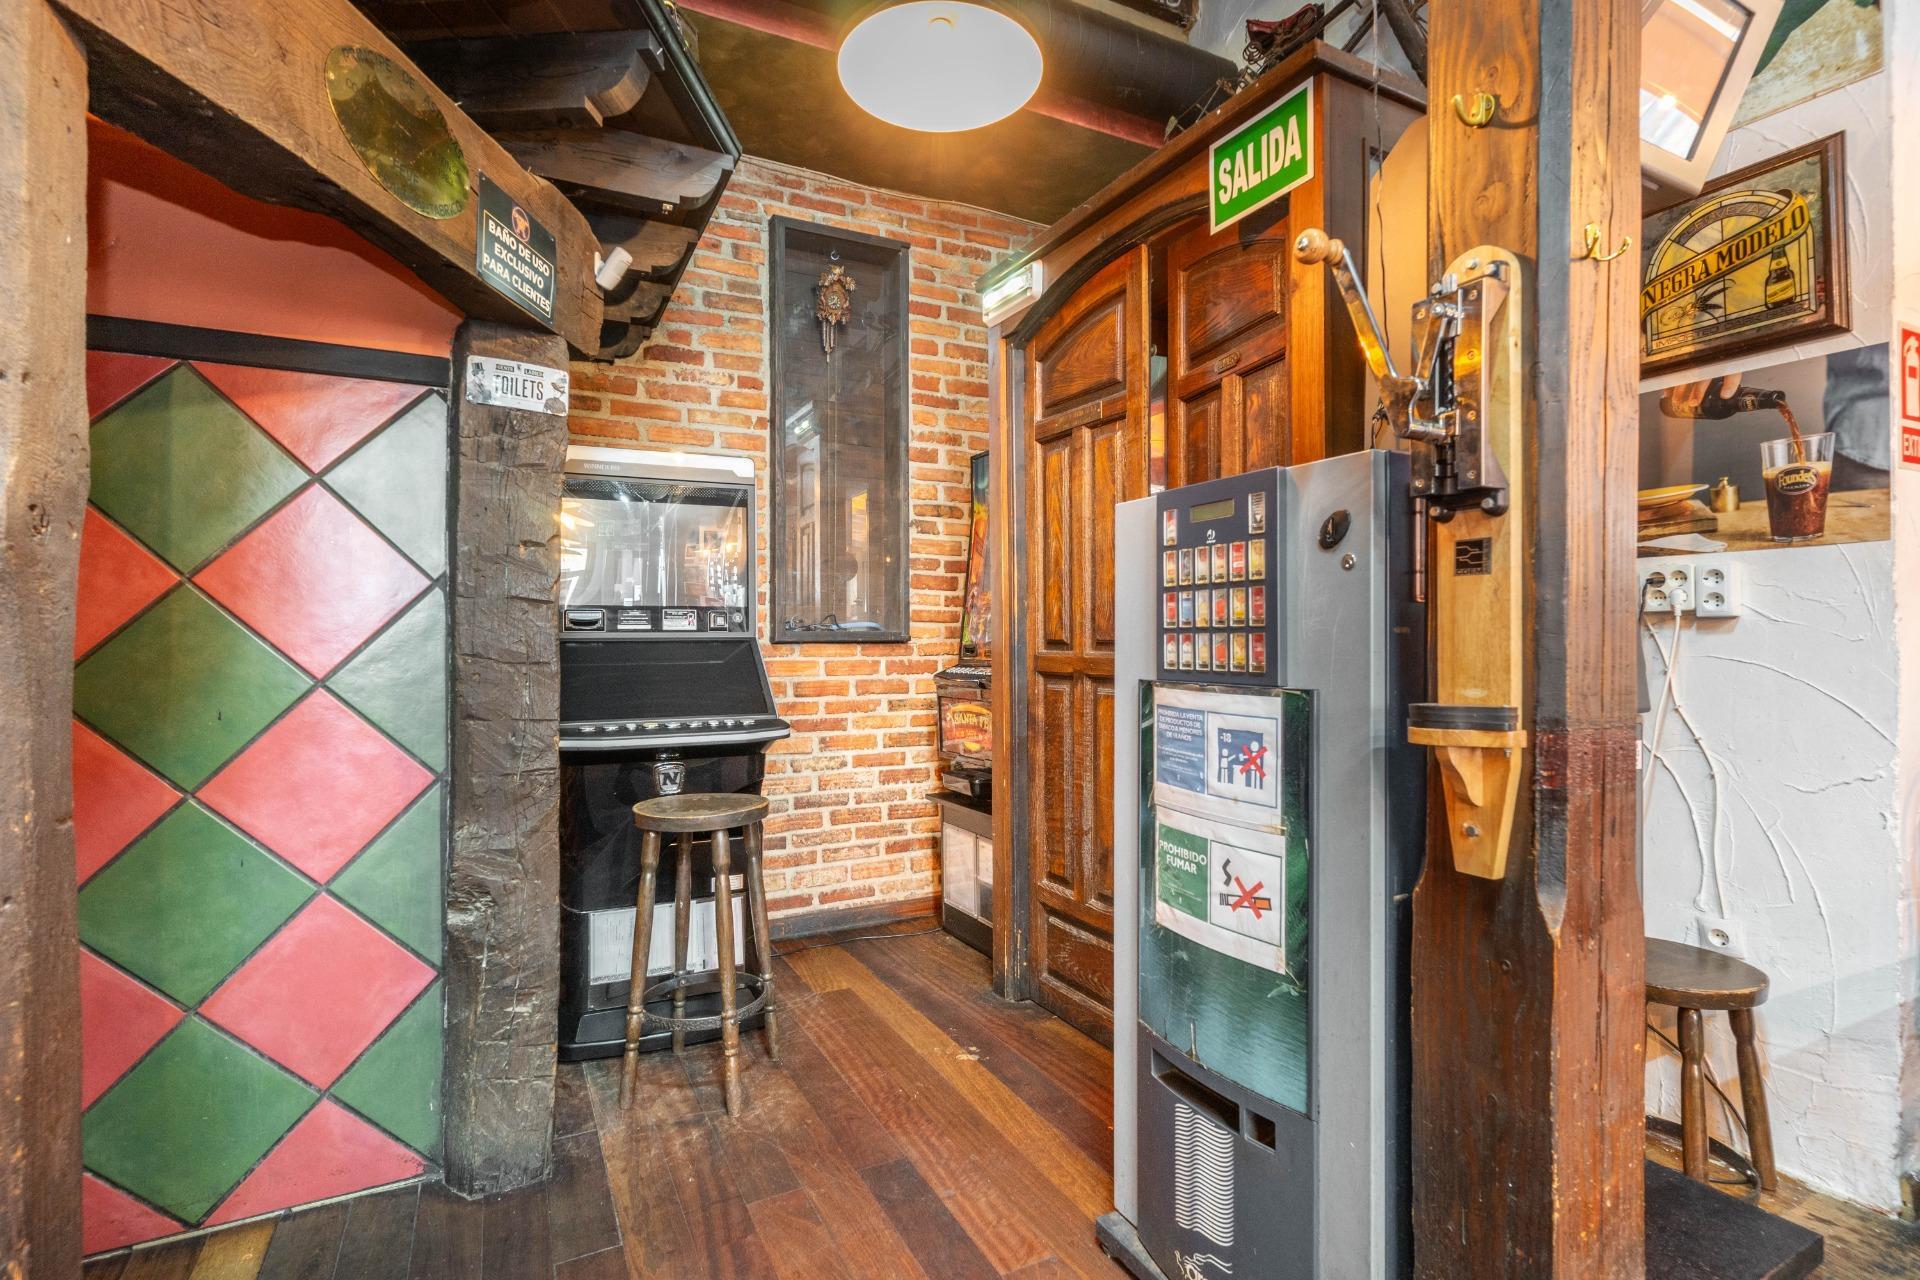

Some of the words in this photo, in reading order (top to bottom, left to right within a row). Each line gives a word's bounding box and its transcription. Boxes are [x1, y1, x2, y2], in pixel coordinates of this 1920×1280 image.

[1218, 115, 1302, 205] SALIDA
[488, 219, 517, 250] BAÑO
[518, 243, 531, 262] DE
[532, 253, 550, 277] USO
[494, 242, 544, 289] EXCLUSIVO
[1642, 260, 1712, 311] NEGRA
[1714, 205, 1806, 272] MODELO
[483, 253, 511, 282] PARA
[512, 275, 551, 312] CLIENTES
[493, 374, 544, 401] TOILETS
[661, 771, 680, 785] N
[1159, 840, 1207, 865] PROHIBIDO
[1166, 855, 1197, 875] FUMAR
